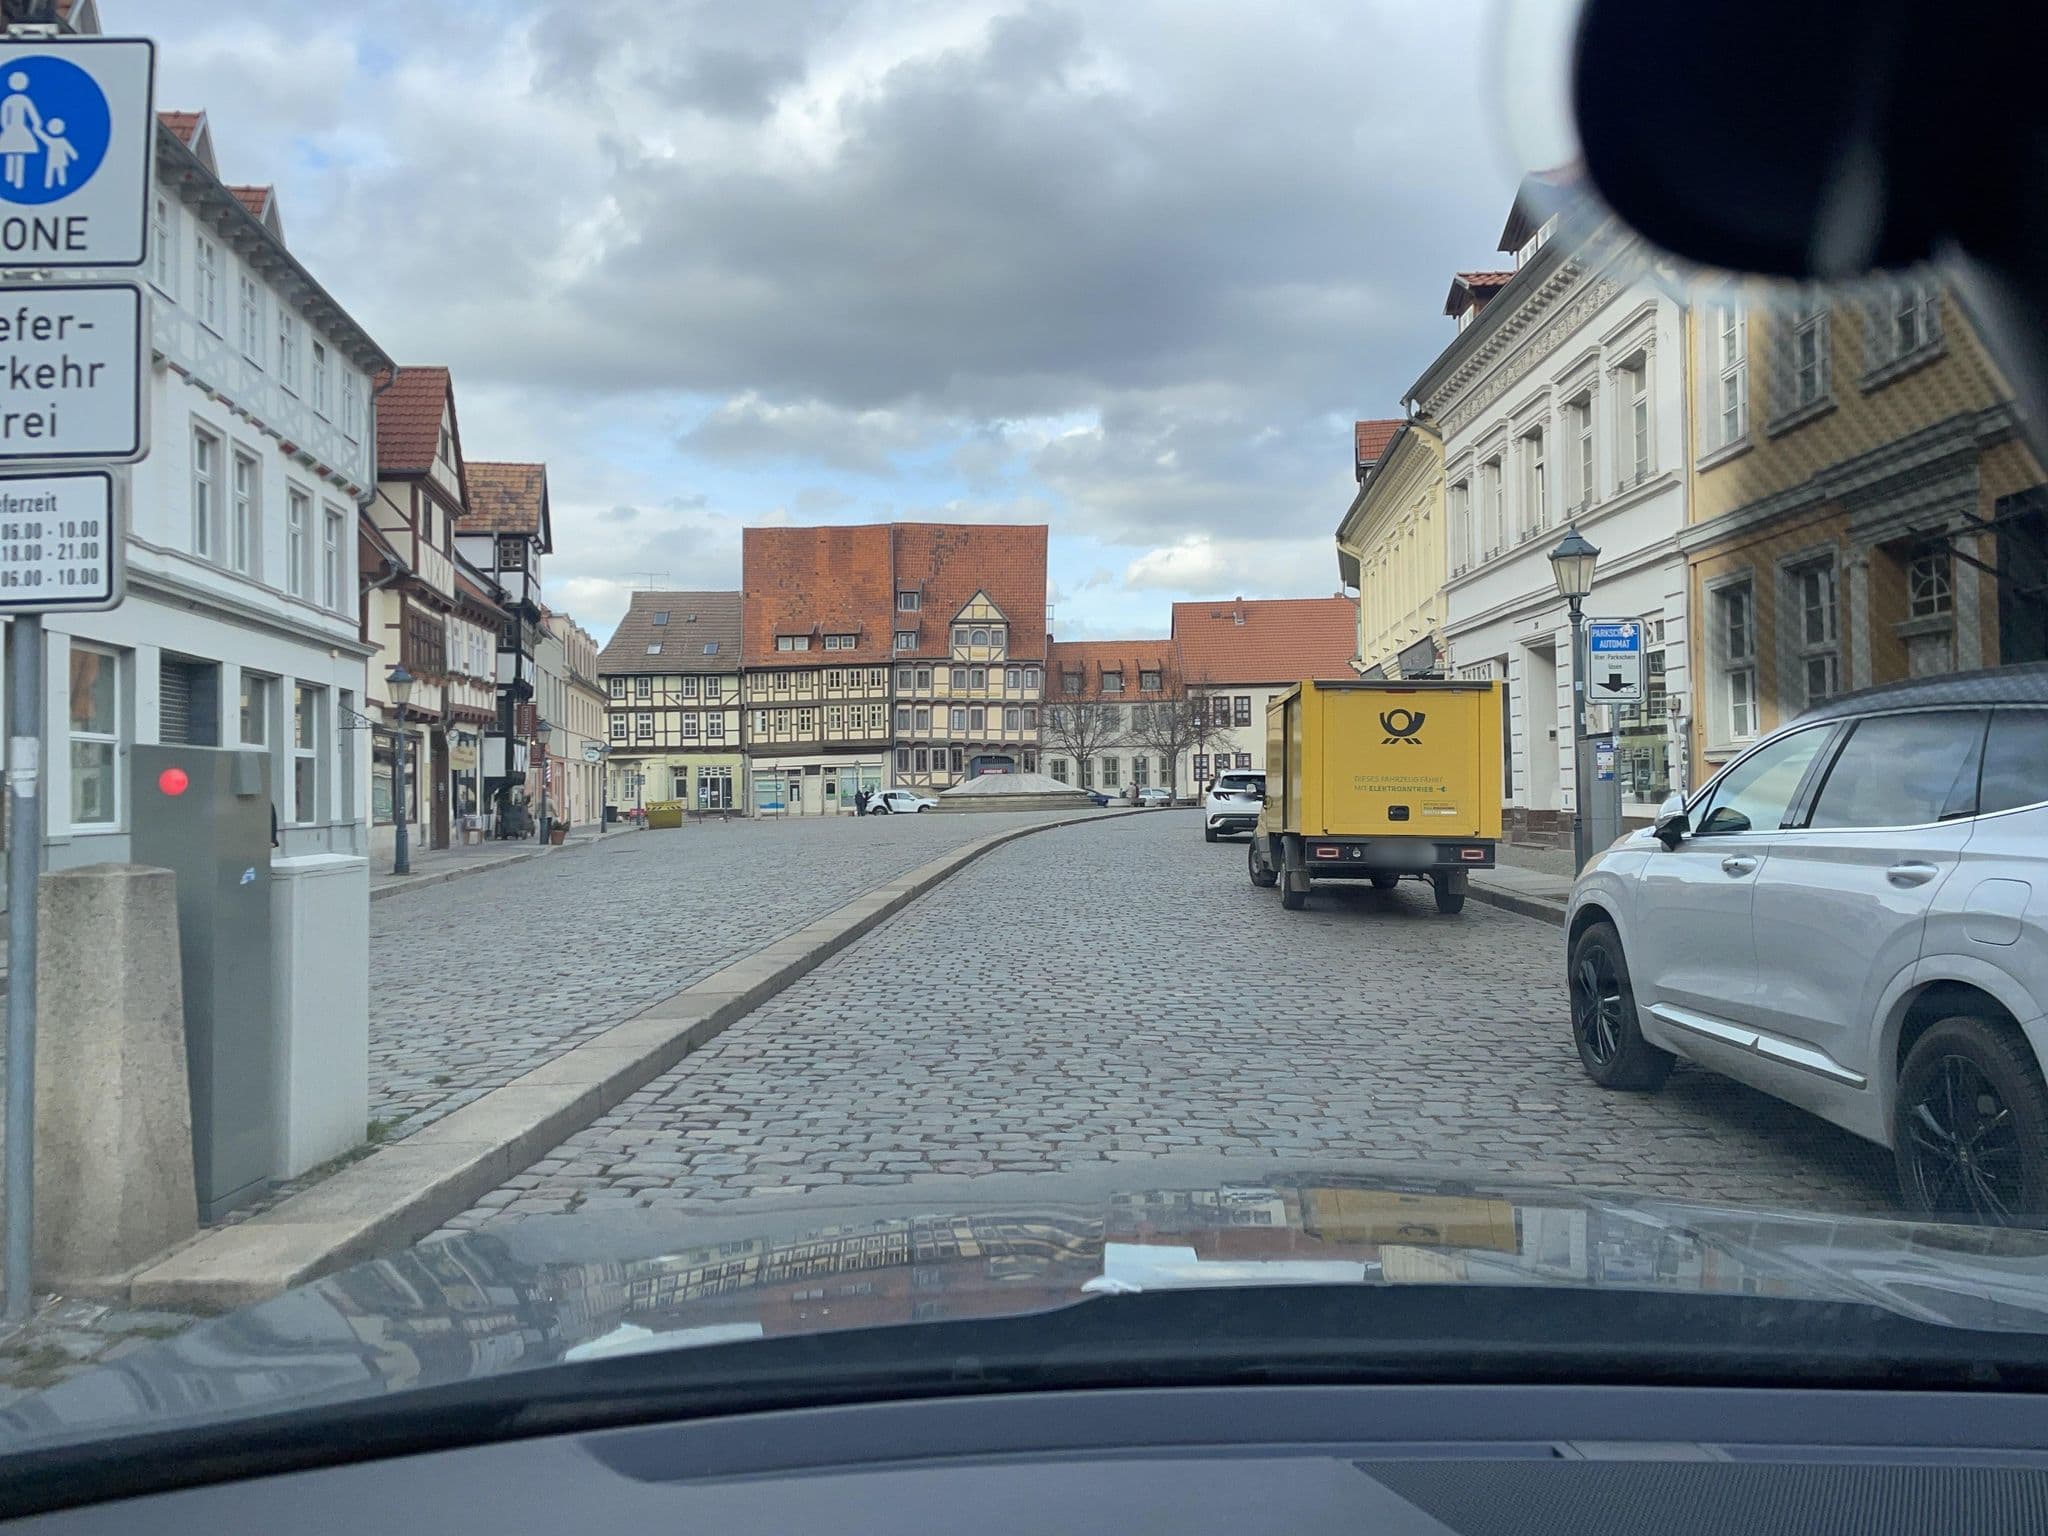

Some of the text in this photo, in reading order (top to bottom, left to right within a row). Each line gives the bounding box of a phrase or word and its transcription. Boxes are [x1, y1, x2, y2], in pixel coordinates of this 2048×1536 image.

[3, 216, 88, 251] ONE
[0, 403, 56, 438] rei
[0, 491, 57, 513] ferzeit
[58, 520, 98, 538] 10.00
[57, 542, 98, 560] 21.00
[58, 567, 98, 585] 10.00
[1599, 639, 1630, 649] AUTOMAT
[1369, 785, 1434, 793] ELEKTROANTRIEB
